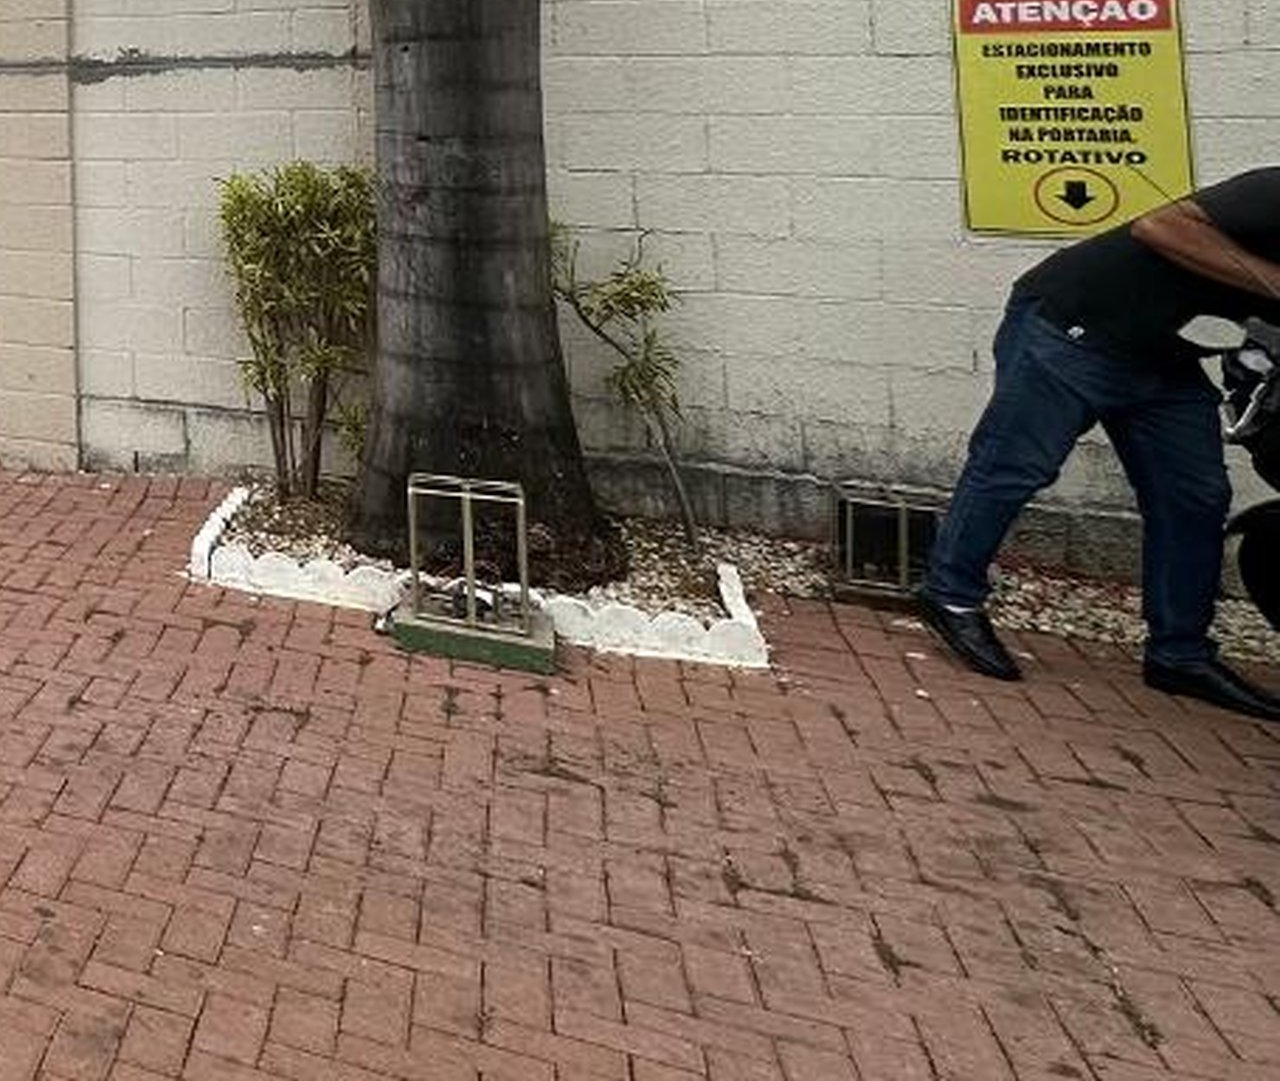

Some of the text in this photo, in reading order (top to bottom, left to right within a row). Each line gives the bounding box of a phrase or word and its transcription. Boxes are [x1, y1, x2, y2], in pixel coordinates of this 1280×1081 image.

[982, 40, 1152, 59] ESTACIONAMENTO
[1015, 62, 1119, 79] EXCLUSIVO
[1042, 85, 1094, 100] PARA
[998, 104, 1144, 124] IDENTIFICAÇÃO
[1008, 128, 1034, 142] NA
[1001, 149, 1147, 166] ROTATIVO
